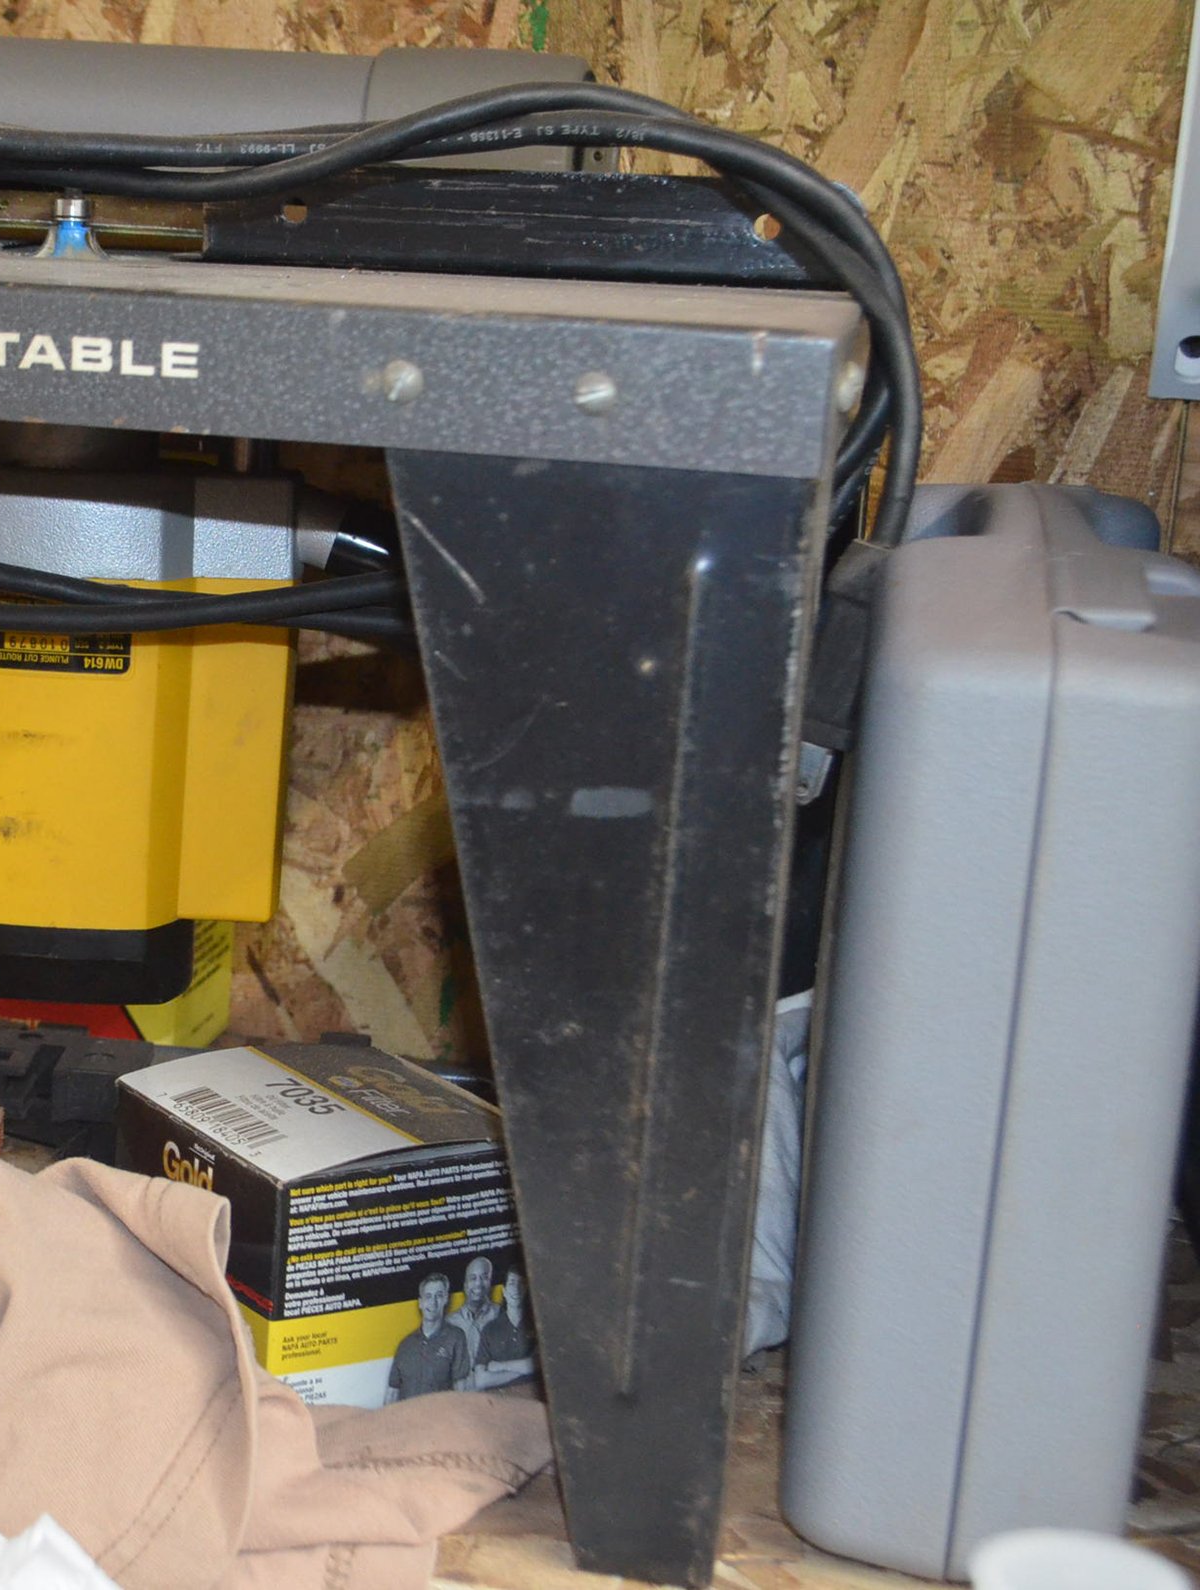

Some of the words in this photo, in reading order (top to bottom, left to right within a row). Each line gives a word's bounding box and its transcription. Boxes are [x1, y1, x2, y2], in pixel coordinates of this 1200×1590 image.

[536, 125, 554, 136] SJ
[561, 125, 600, 136] TYPE
[24, 652, 38, 663] CUT
[40, 654, 70, 665] PLUNGE
[84, 656, 124, 670] DW614
[266, 1077, 346, 1116] 7035
[173, 1101, 211, 1124] 65809
[163, 1140, 214, 1191] Gold
